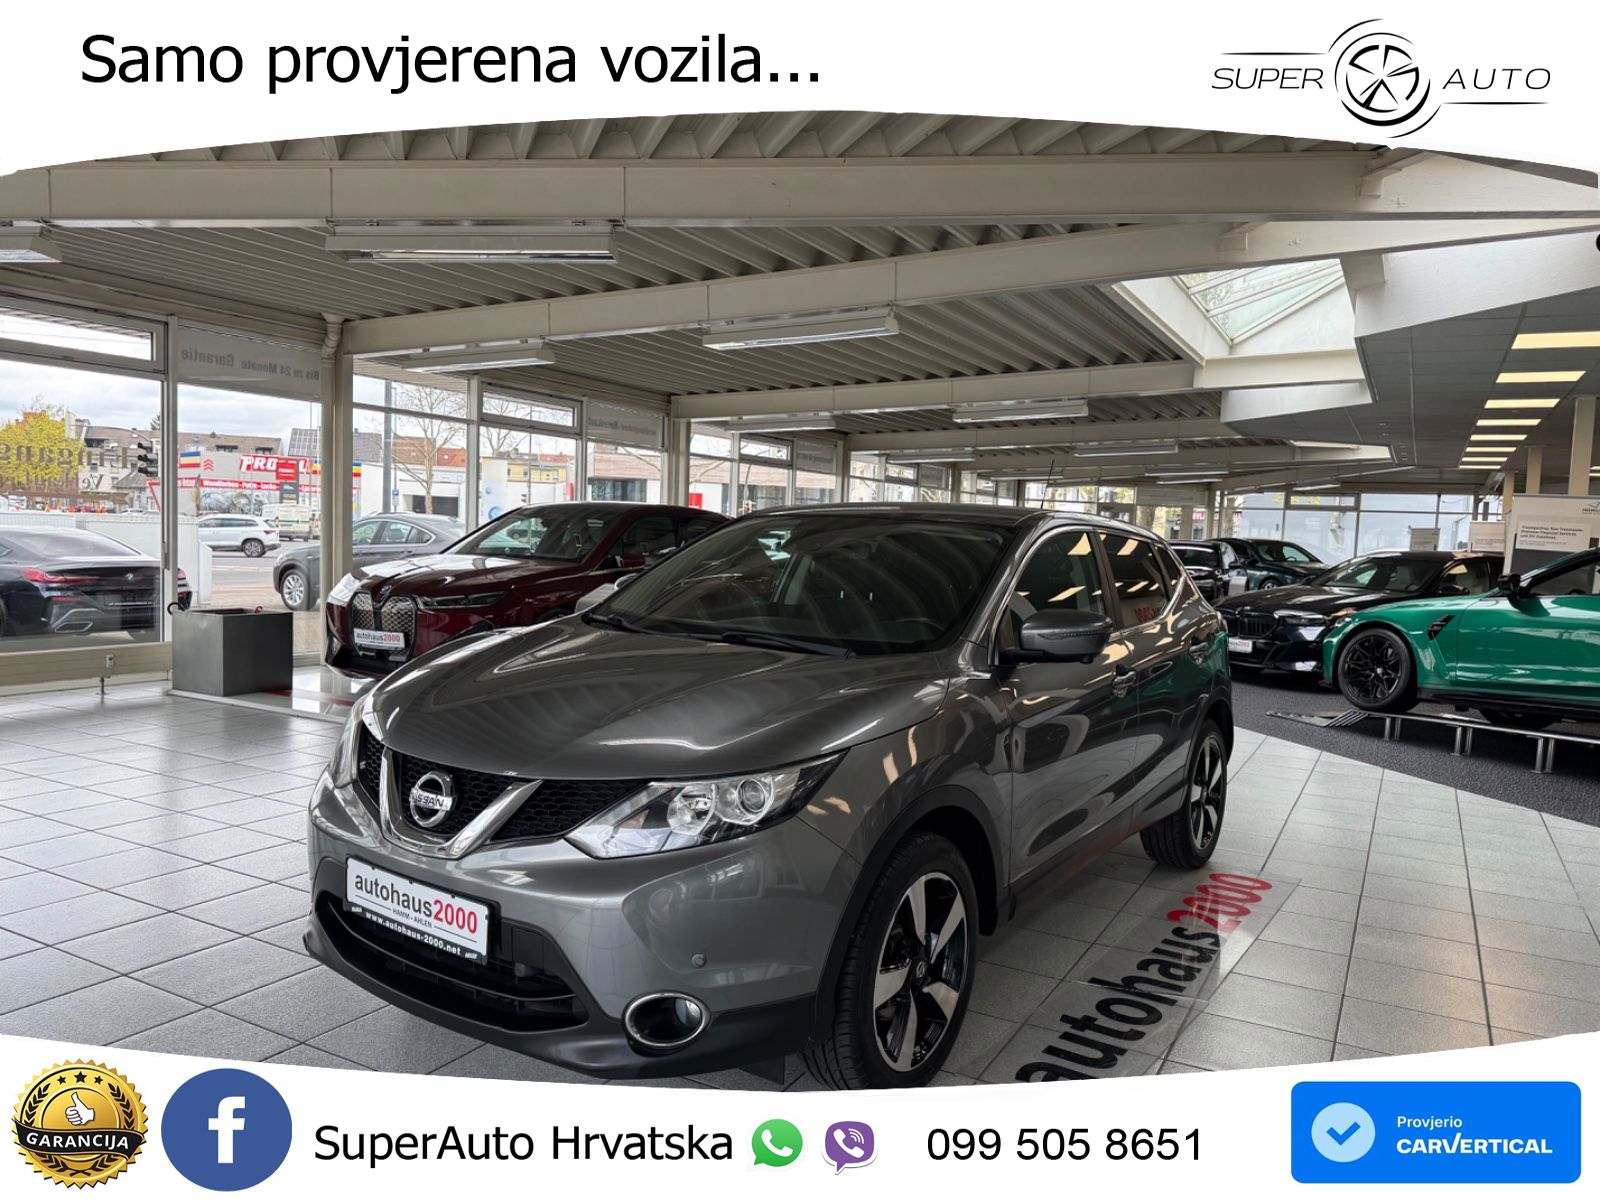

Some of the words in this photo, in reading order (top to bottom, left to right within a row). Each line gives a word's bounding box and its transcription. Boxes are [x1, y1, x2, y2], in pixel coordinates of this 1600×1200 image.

[354, 873, 478, 934] autohaus2000
[392, 908, 410, 920] HAMM
[413, 915, 433, 929] AHLEN
[364, 911, 461, 956] www.autohaus-2000.net
